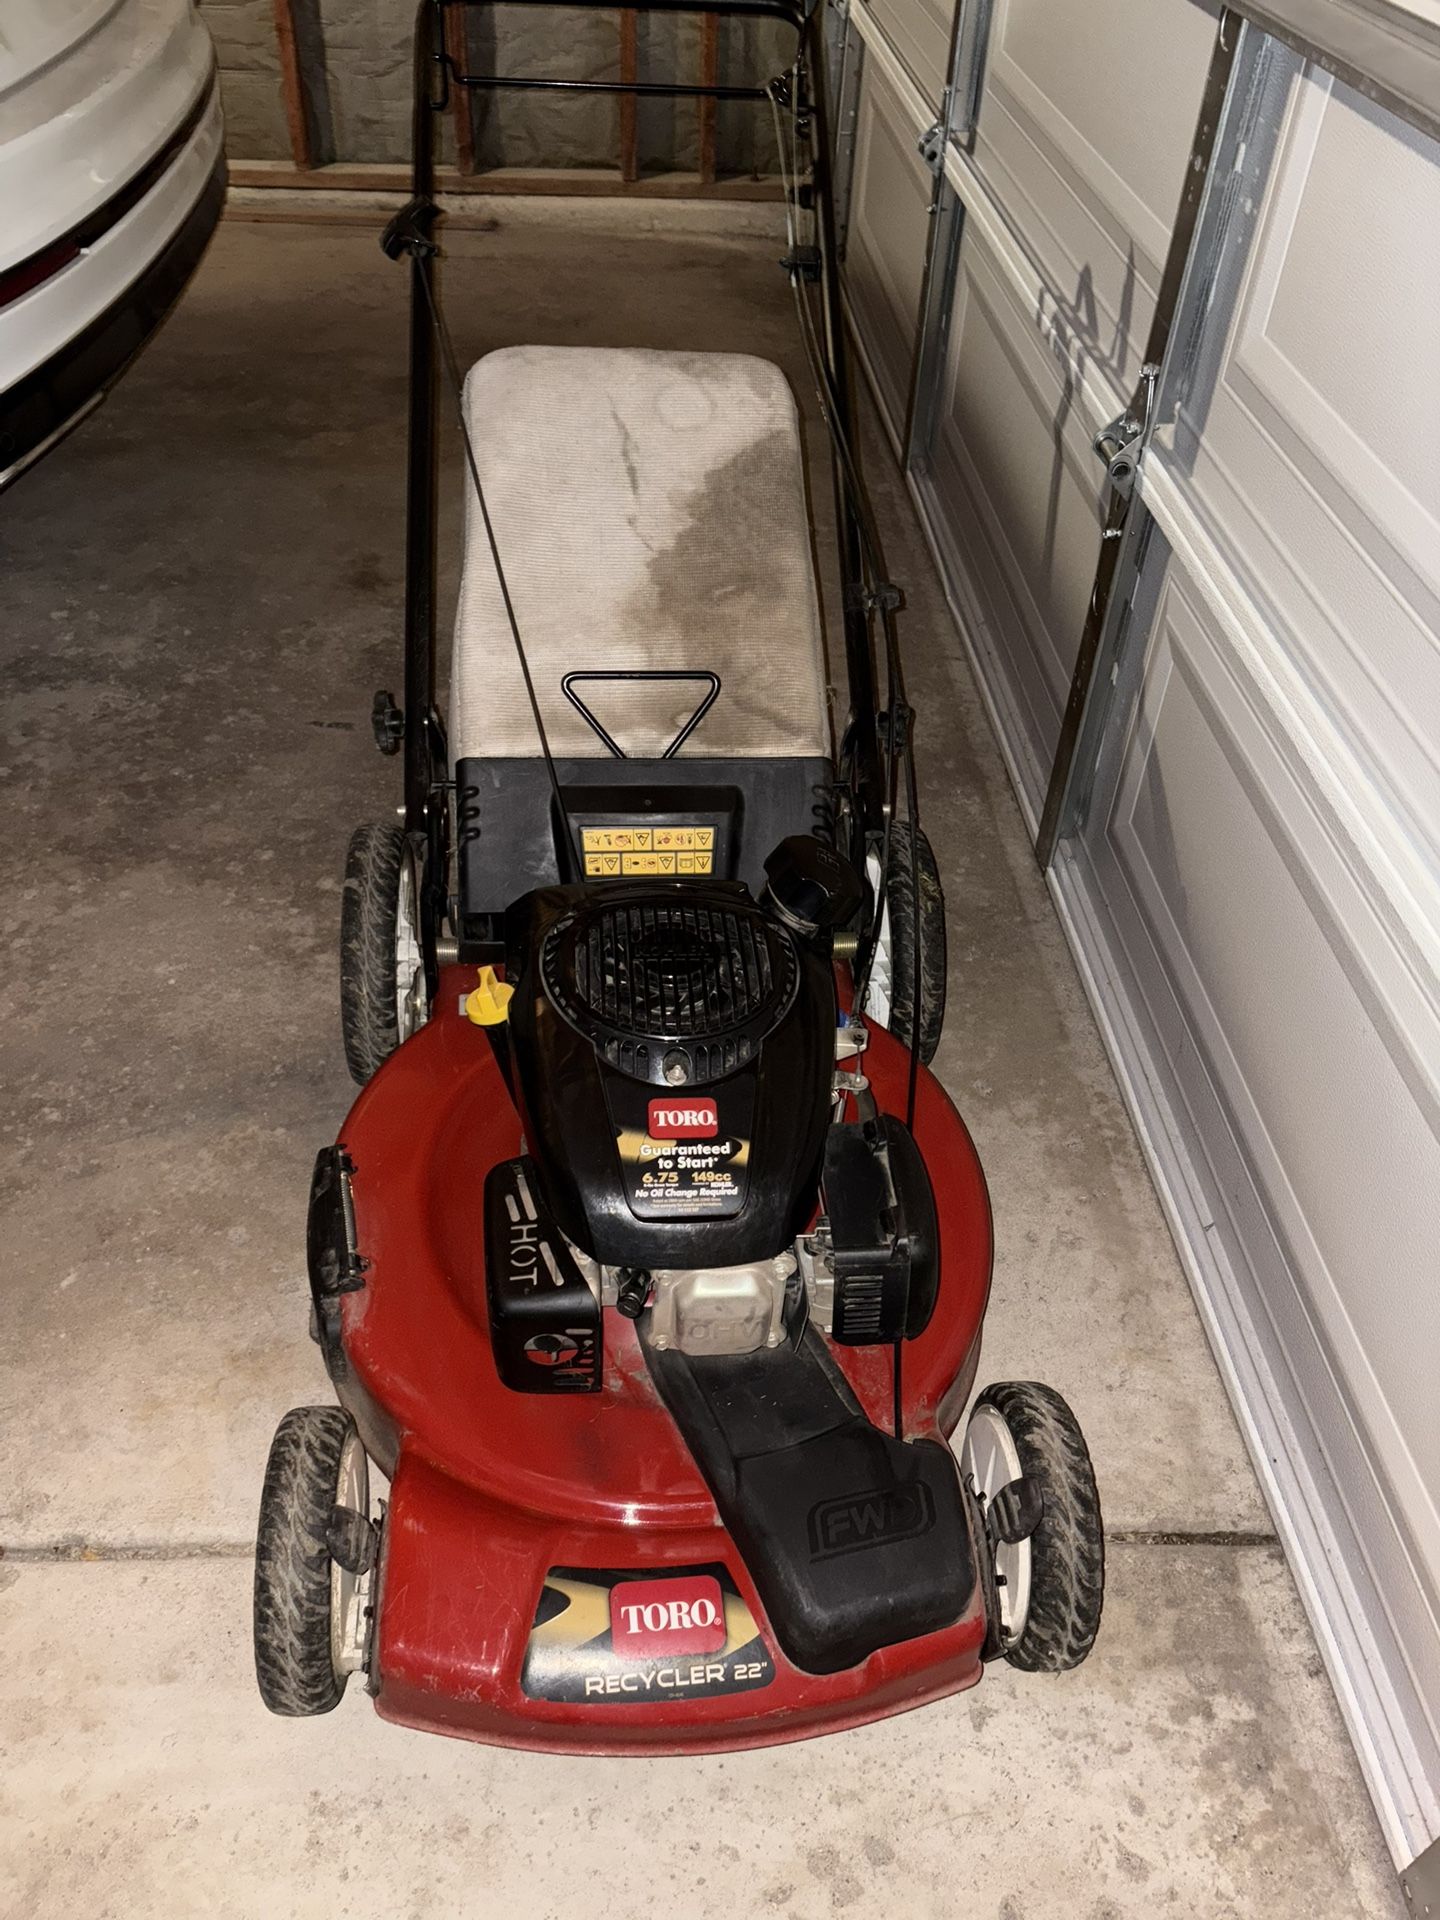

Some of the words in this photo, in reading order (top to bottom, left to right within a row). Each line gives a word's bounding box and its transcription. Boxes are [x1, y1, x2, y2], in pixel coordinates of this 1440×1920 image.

[640, 1141, 731, 1156] Guaranteed
[657, 1158, 674, 1169] to
[642, 1171, 679, 1184] 6.75
[691, 1171, 732, 1183] 149cc
[634, 1189, 649, 1198] No
[650, 1187, 663, 1198] Oil
[665, 1187, 698, 1199] Change
[699, 1186, 738, 1199] Required
[509, 1224, 538, 1286] HOT
[688, 1321, 764, 1339] OHV
[585, 1664, 726, 1696] RECYCLER
[734, 1661, 768, 1680] 22"
